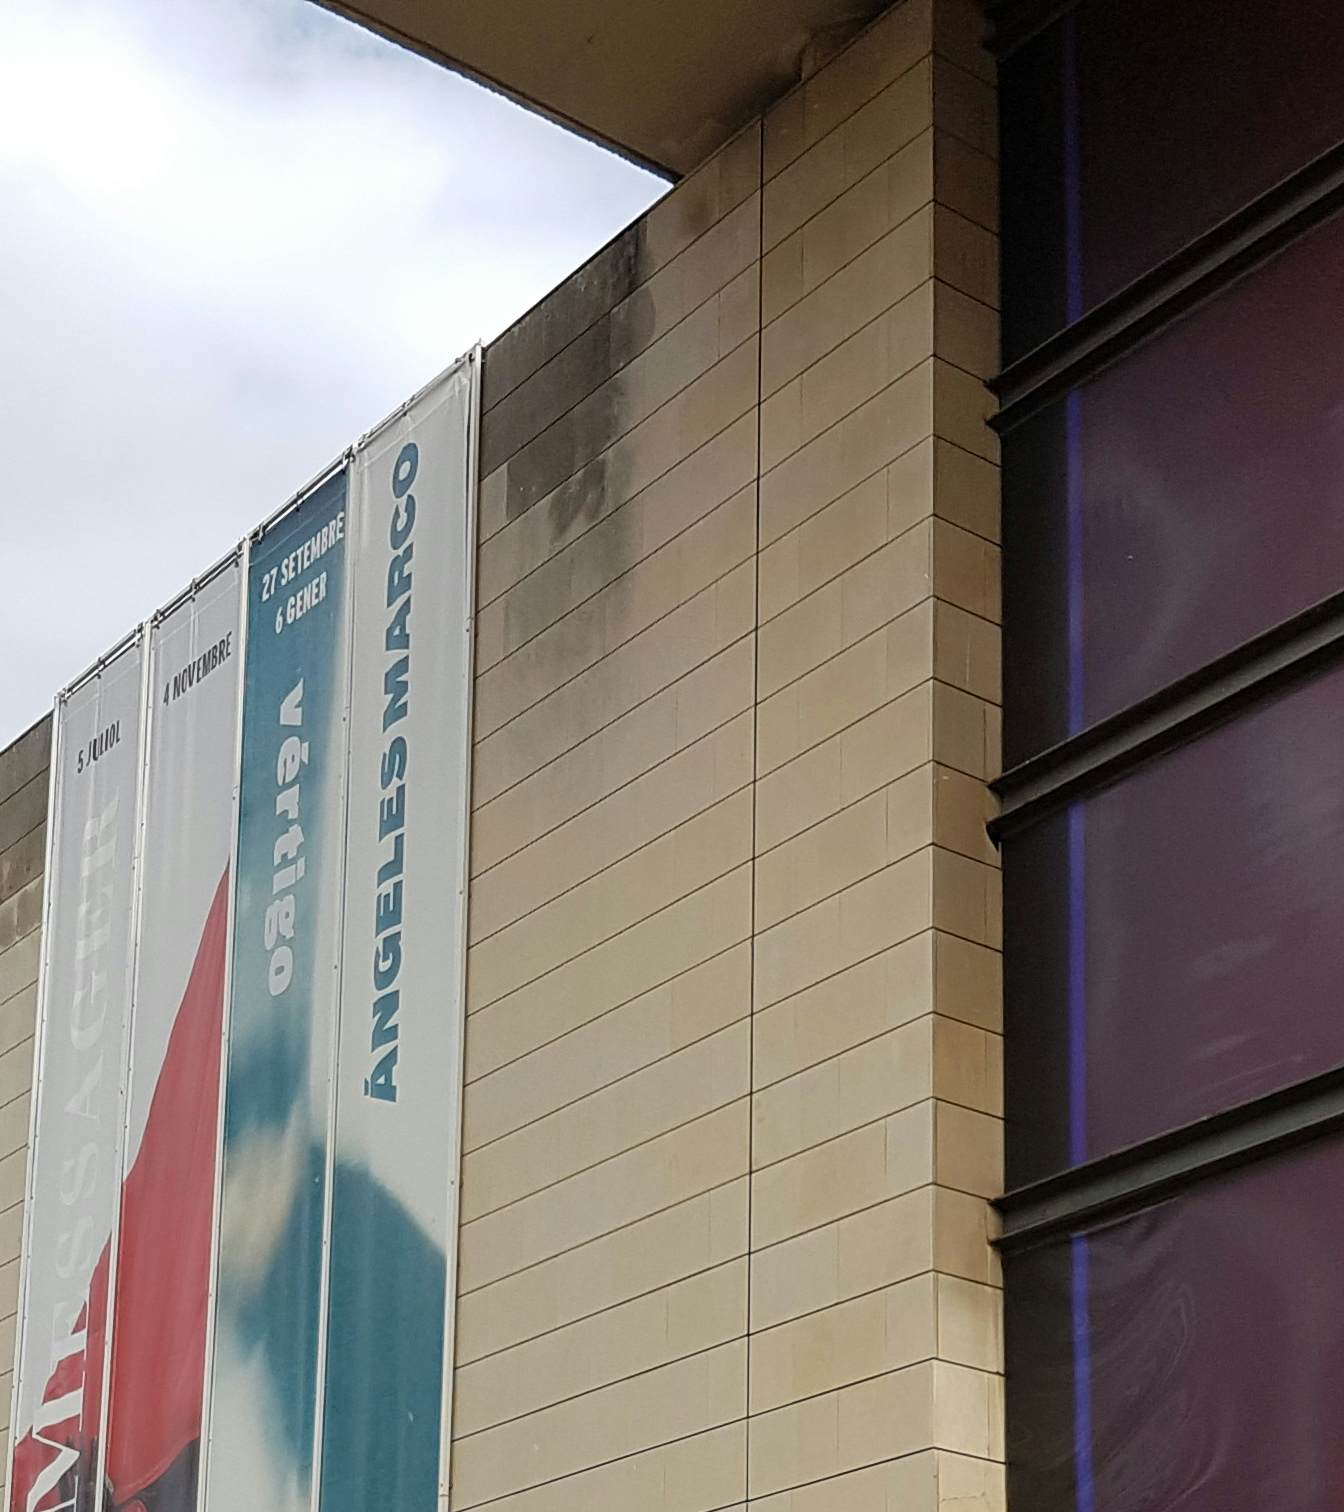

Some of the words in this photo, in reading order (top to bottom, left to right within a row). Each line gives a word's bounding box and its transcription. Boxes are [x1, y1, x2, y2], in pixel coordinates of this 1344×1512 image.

[261, 566, 278, 602] 27
[281, 511, 346, 587] SETEMBRE
[381, 441, 420, 734] MARCO
[274, 608, 284, 635] 6
[286, 571, 328, 626] GENER
[163, 682, 170, 706] 4
[173, 631, 233, 701] NOVEMBRE
[77, 750, 84, 774] 5
[86, 720, 121, 767] JULIOL
